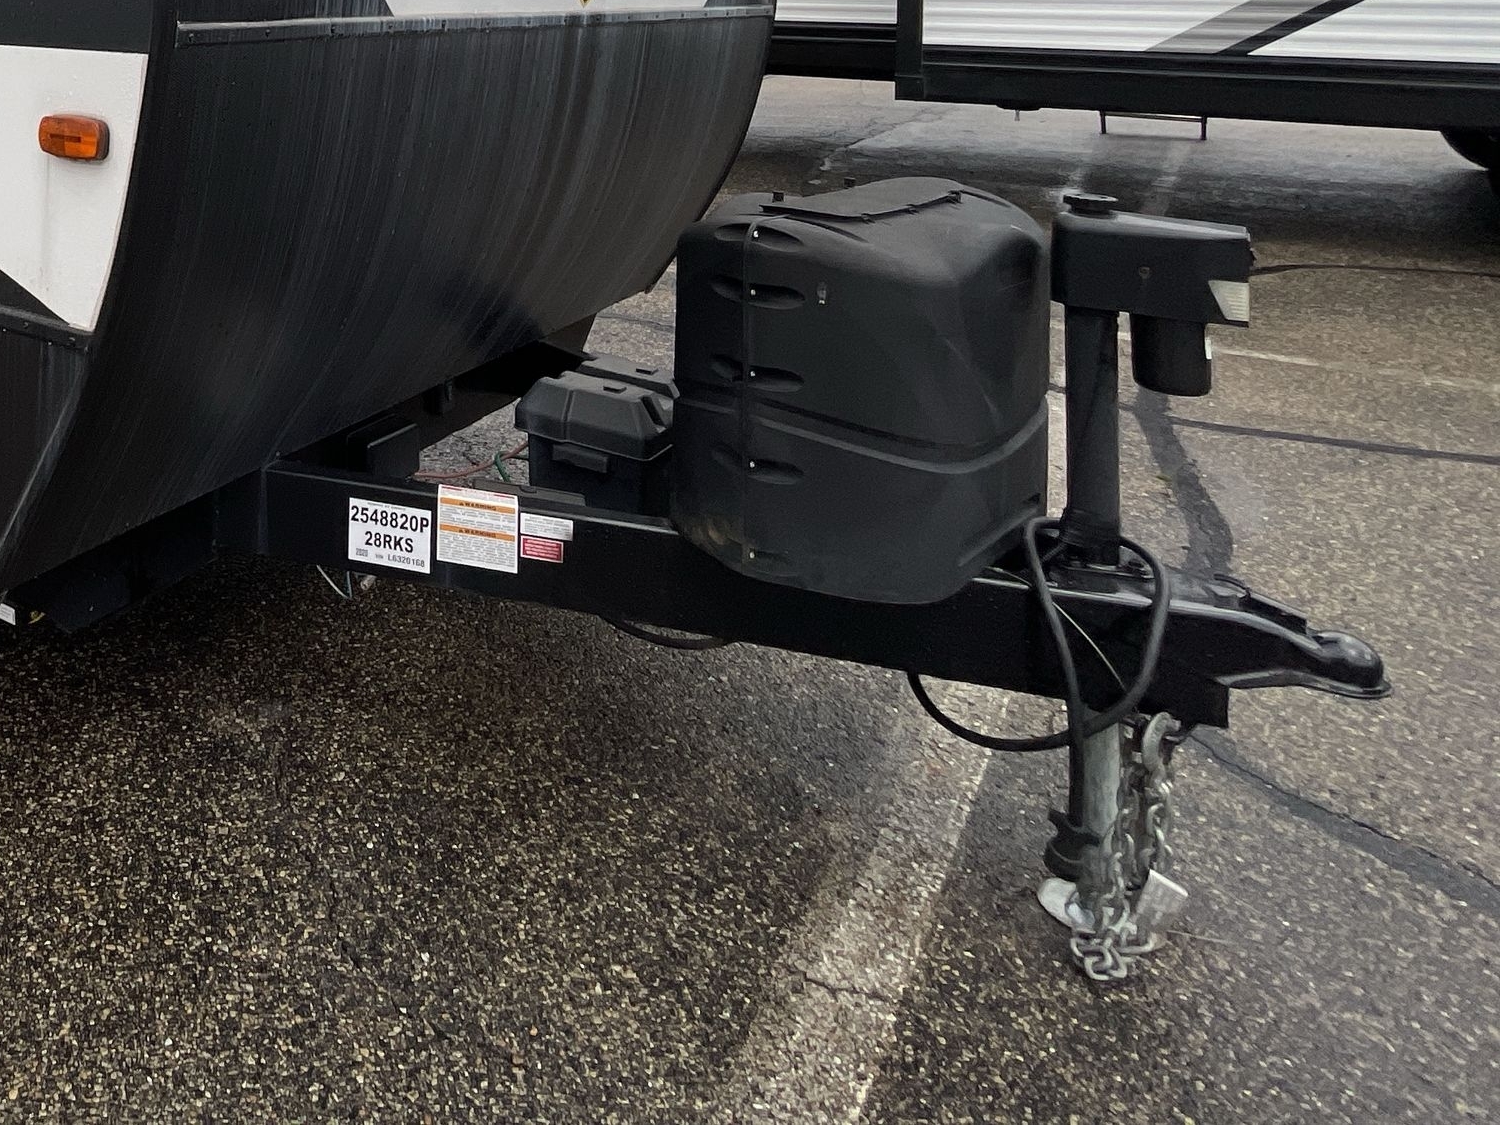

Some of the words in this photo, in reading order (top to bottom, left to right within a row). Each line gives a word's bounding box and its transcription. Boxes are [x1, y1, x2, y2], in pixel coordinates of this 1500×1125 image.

[464, 502, 497, 512] WARNING
[351, 505, 429, 533] 2548820P
[364, 531, 414, 553] 28RKS
[463, 529, 497, 539] WARNING
